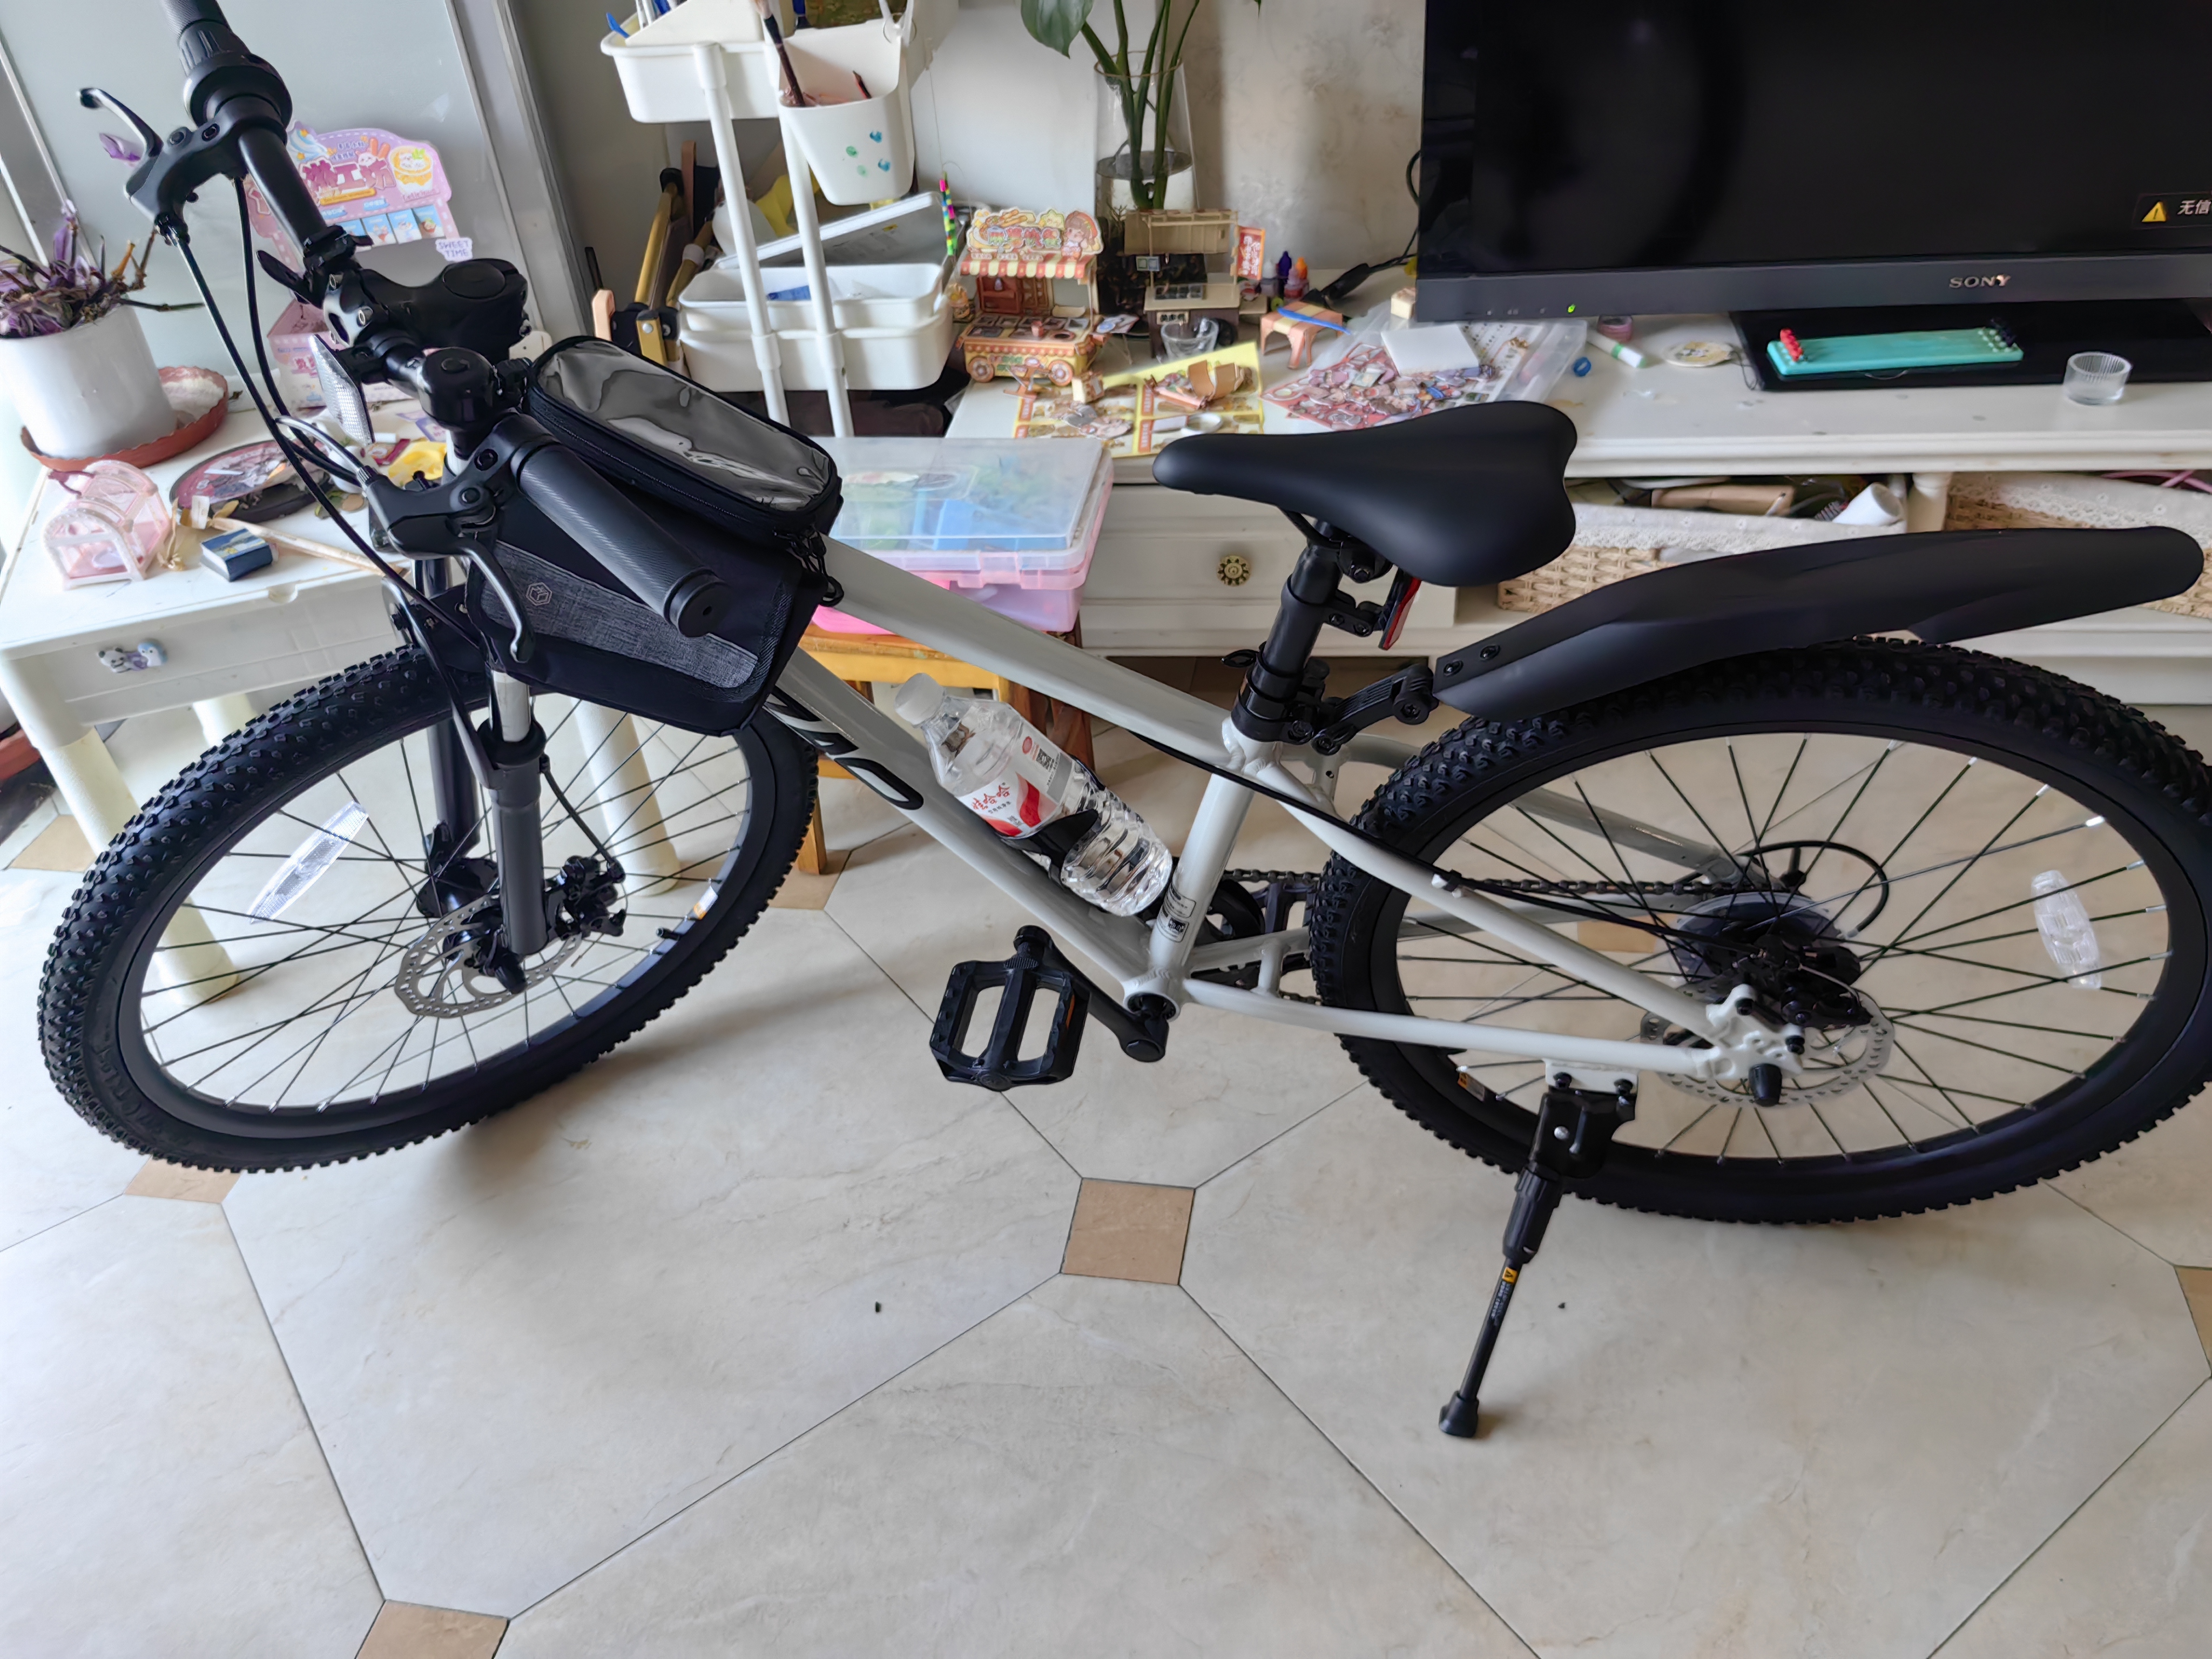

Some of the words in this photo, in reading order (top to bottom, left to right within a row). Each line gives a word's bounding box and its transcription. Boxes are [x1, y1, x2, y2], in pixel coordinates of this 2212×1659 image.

[439, 240, 469, 249] SWEET
[445, 248, 469, 257] TIME
[1949, 274, 2011, 288] SONY
[972, 785, 1010, 810] 娃哈哈
